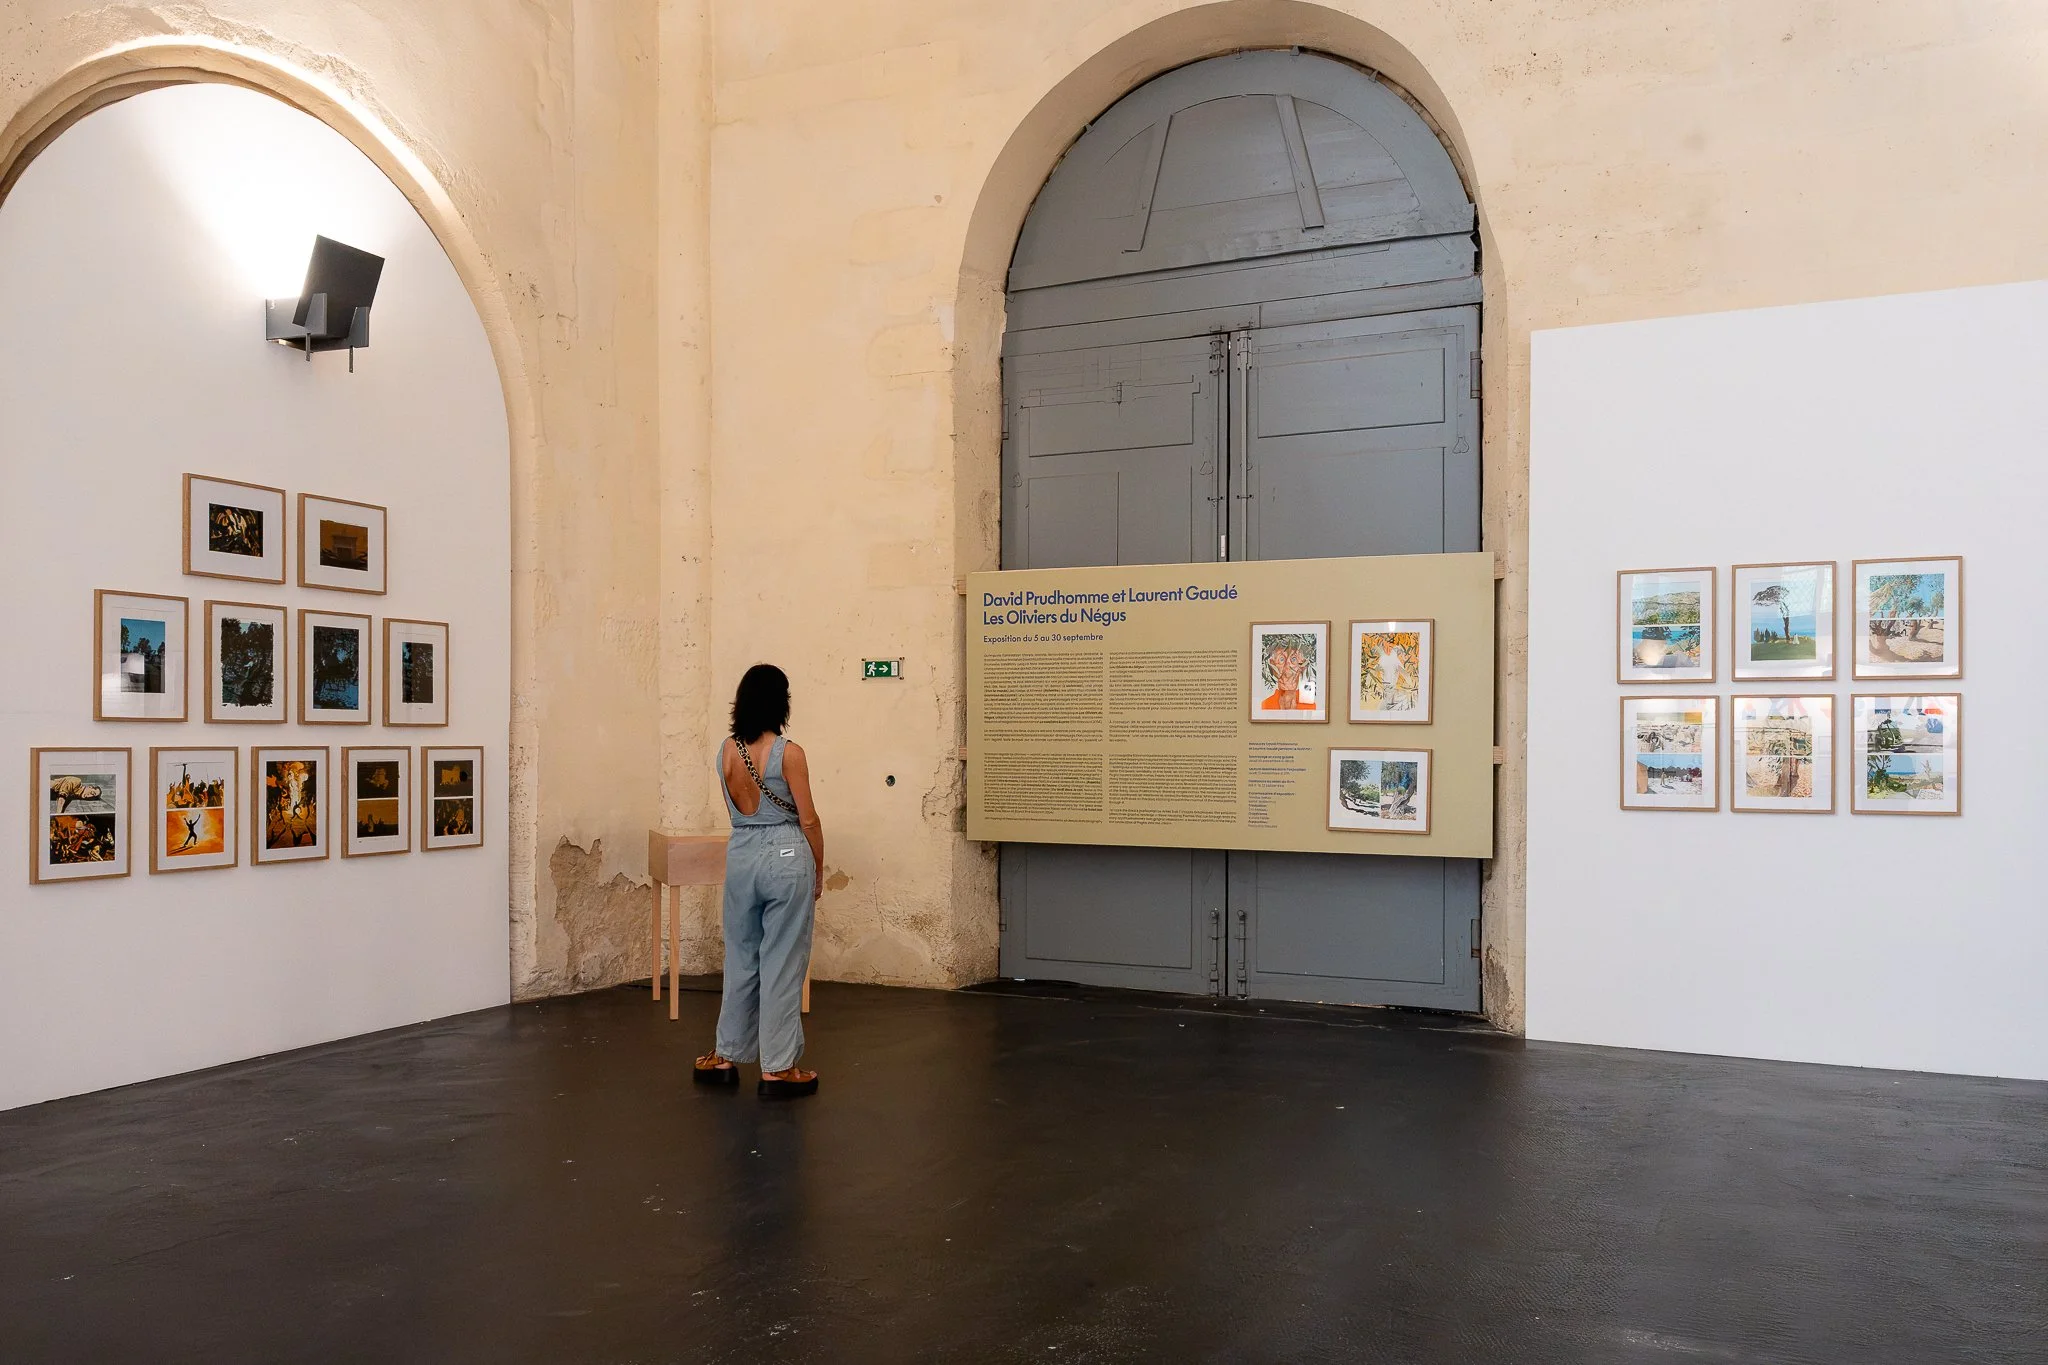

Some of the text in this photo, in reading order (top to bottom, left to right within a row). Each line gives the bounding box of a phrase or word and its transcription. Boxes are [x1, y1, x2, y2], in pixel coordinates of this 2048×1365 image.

[983, 583, 1238, 607] David Prudhomme et Laurent Gaudé
[983, 607, 1127, 627] Les Oliviers du Négus
[983, 635, 1022, 645] Exposition
[1023, 634, 1033, 642] du
[1033, 634, 1039, 642] 5
[1051, 633, 1062, 642] 30
[1062, 632, 1104, 643] septembre
